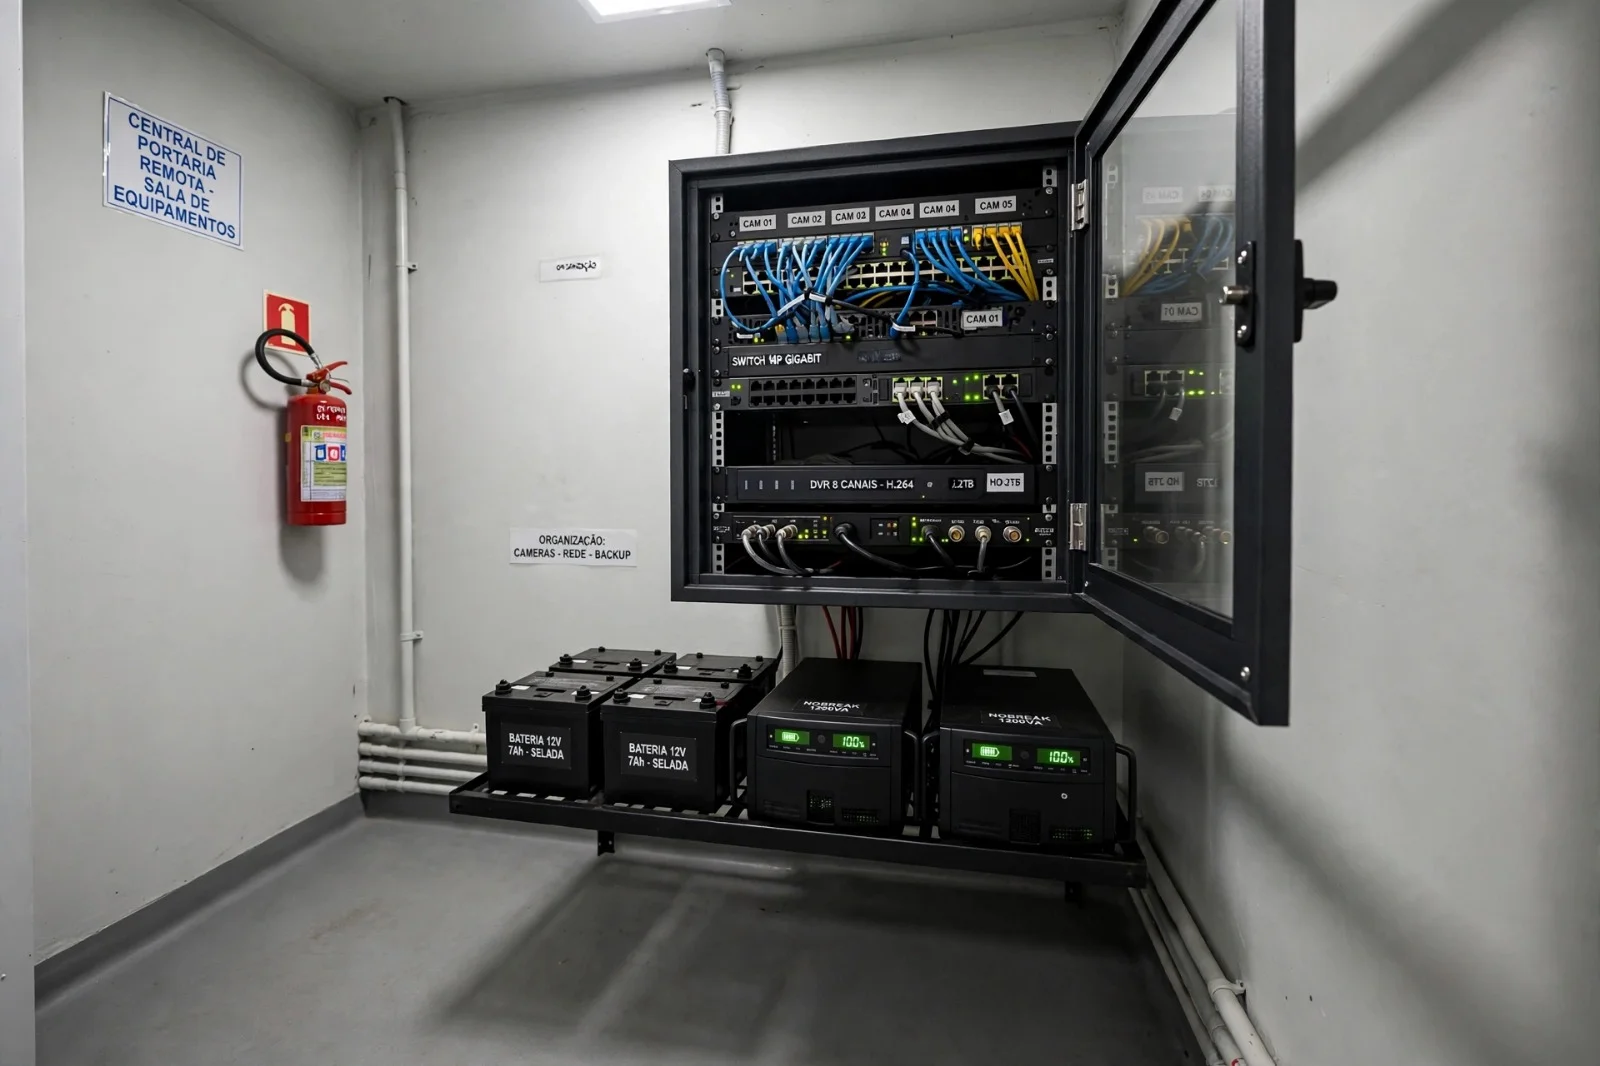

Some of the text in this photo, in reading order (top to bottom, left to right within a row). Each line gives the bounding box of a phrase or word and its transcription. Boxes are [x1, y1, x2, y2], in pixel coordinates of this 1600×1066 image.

[128, 112, 226, 166] CENTRAL DE
[137, 134, 217, 180] PORTARIA
[140, 154, 205, 194] REMOTA
[144, 176, 210, 214] SALA DE
[113, 184, 236, 239] EQUIPAMENTOS
[923, 204, 956, 215] CAM 04
[980, 199, 1013, 211] CAM 05
[835, 212, 854, 222] CAM
[878, 208, 898, 218] CAM
[743, 218, 772, 228] CAM 01
[791, 215, 822, 225] CAM 02
[966, 313, 999, 324] CAM 01
[732, 355, 766, 366] SWITCH
[784, 353, 822, 365] GIGABIT
[810, 479, 831, 489] DVR
[832, 479, 839, 489] 8
[840, 479, 878, 489] CANAIS
[886, 479, 914, 489] H.264
[538, 533, 606, 546] ORGANIZAÇÃO:
[513, 548, 556, 558] CAMERAS
[563, 549, 587, 559] REDE
[595, 550, 632, 560] BACKUP
[803, 700, 860, 709] NOBREAK
[988, 712, 1052, 722] NOBREAK
[508, 732, 562, 747] BATERIA 12V
[508, 744, 524, 756] 7Ah
[530, 747, 565, 760] SELADA
[628, 742, 687, 757] BATERIA 12V
[627, 755, 645, 767] 7Ah
[652, 757, 689, 771] SELADA
[1049, 750, 1074, 764] 100%
